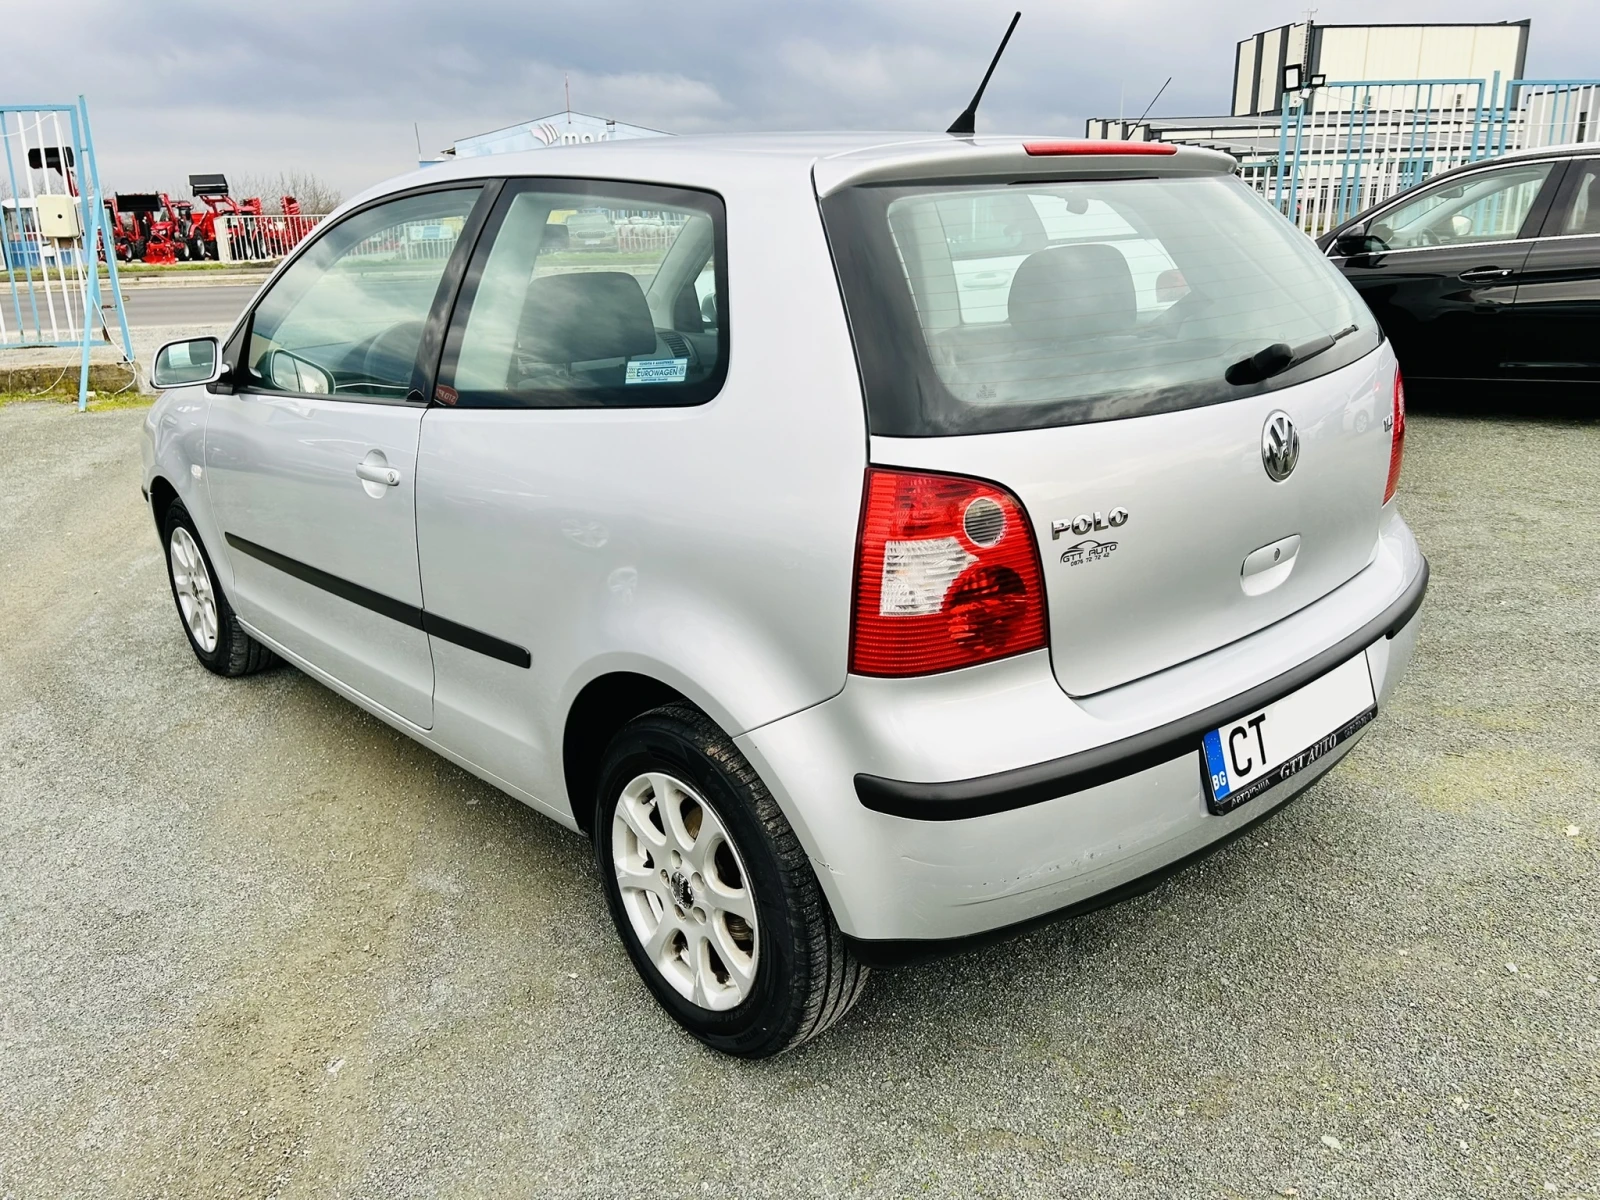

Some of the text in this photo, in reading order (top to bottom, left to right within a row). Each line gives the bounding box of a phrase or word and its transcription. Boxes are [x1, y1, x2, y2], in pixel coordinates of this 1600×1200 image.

[636, 367, 678, 377] EUROWAGEN
[1051, 506, 1129, 541] POLO
[1062, 544, 1117, 563] GTT AUTO
[1228, 712, 1267, 778] CT
[1280, 733, 1337, 780] GTT AUTO
[1212, 770, 1227, 791] BG
